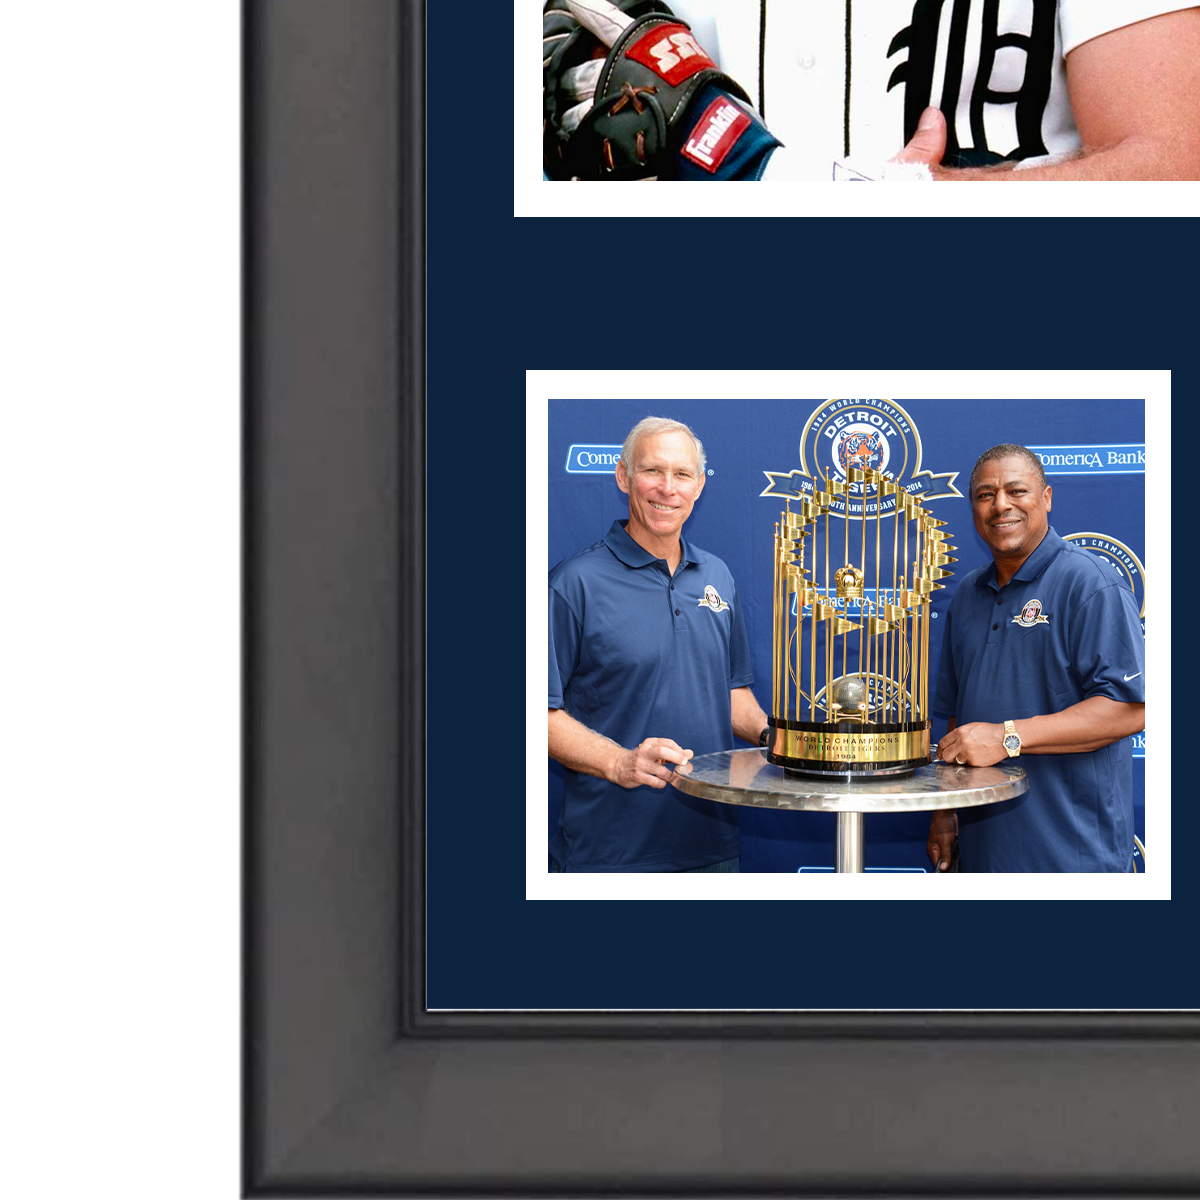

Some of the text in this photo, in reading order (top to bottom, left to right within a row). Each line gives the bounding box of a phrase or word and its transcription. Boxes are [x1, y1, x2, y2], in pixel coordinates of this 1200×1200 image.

[824, 411, 897, 439] DETROIT
[865, 398, 911, 434] CHAMPIONS
[576, 451, 621, 467] Come
[1091, 539, 1138, 575] CHAMPIONS
[795, 735, 900, 745] WORLD CHAMPIONS
